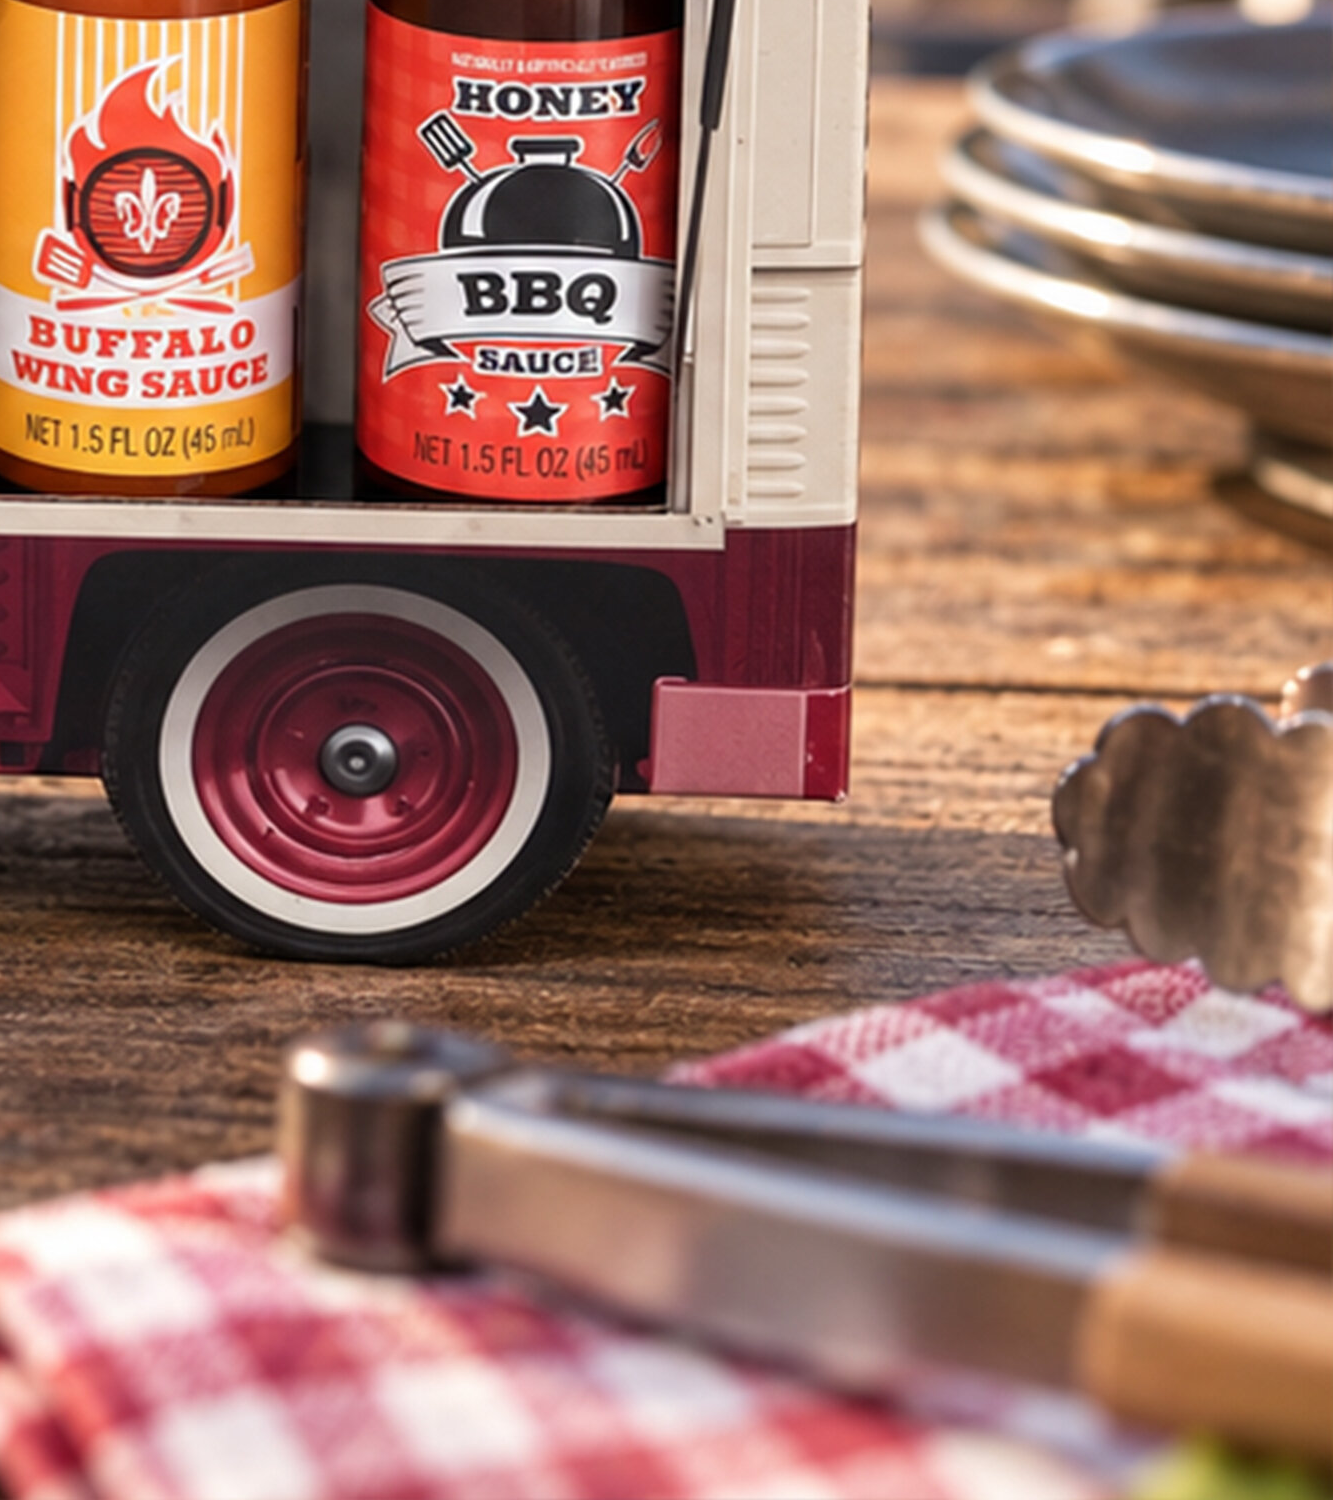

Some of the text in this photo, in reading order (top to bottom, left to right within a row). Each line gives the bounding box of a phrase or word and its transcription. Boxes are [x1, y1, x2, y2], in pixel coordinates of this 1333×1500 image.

[453, 78, 644, 119] HONEY
[456, 271, 617, 325] BBQ
[29, 315, 256, 359] BUFFALO
[11, 349, 268, 398] WING SAUCE
[476, 347, 600, 375] SAUCE
[26, 413, 61, 447] NET
[71, 423, 104, 455] 1.5
[110, 425, 138, 457] FL
[145, 426, 176, 458] OZ
[183, 424, 217, 460] (45
[413, 432, 452, 466] NET
[461, 443, 495, 474] 1.5
[501, 446, 530, 477] FL
[536, 447, 569, 478] OZ
[576, 445, 611, 481] (45
